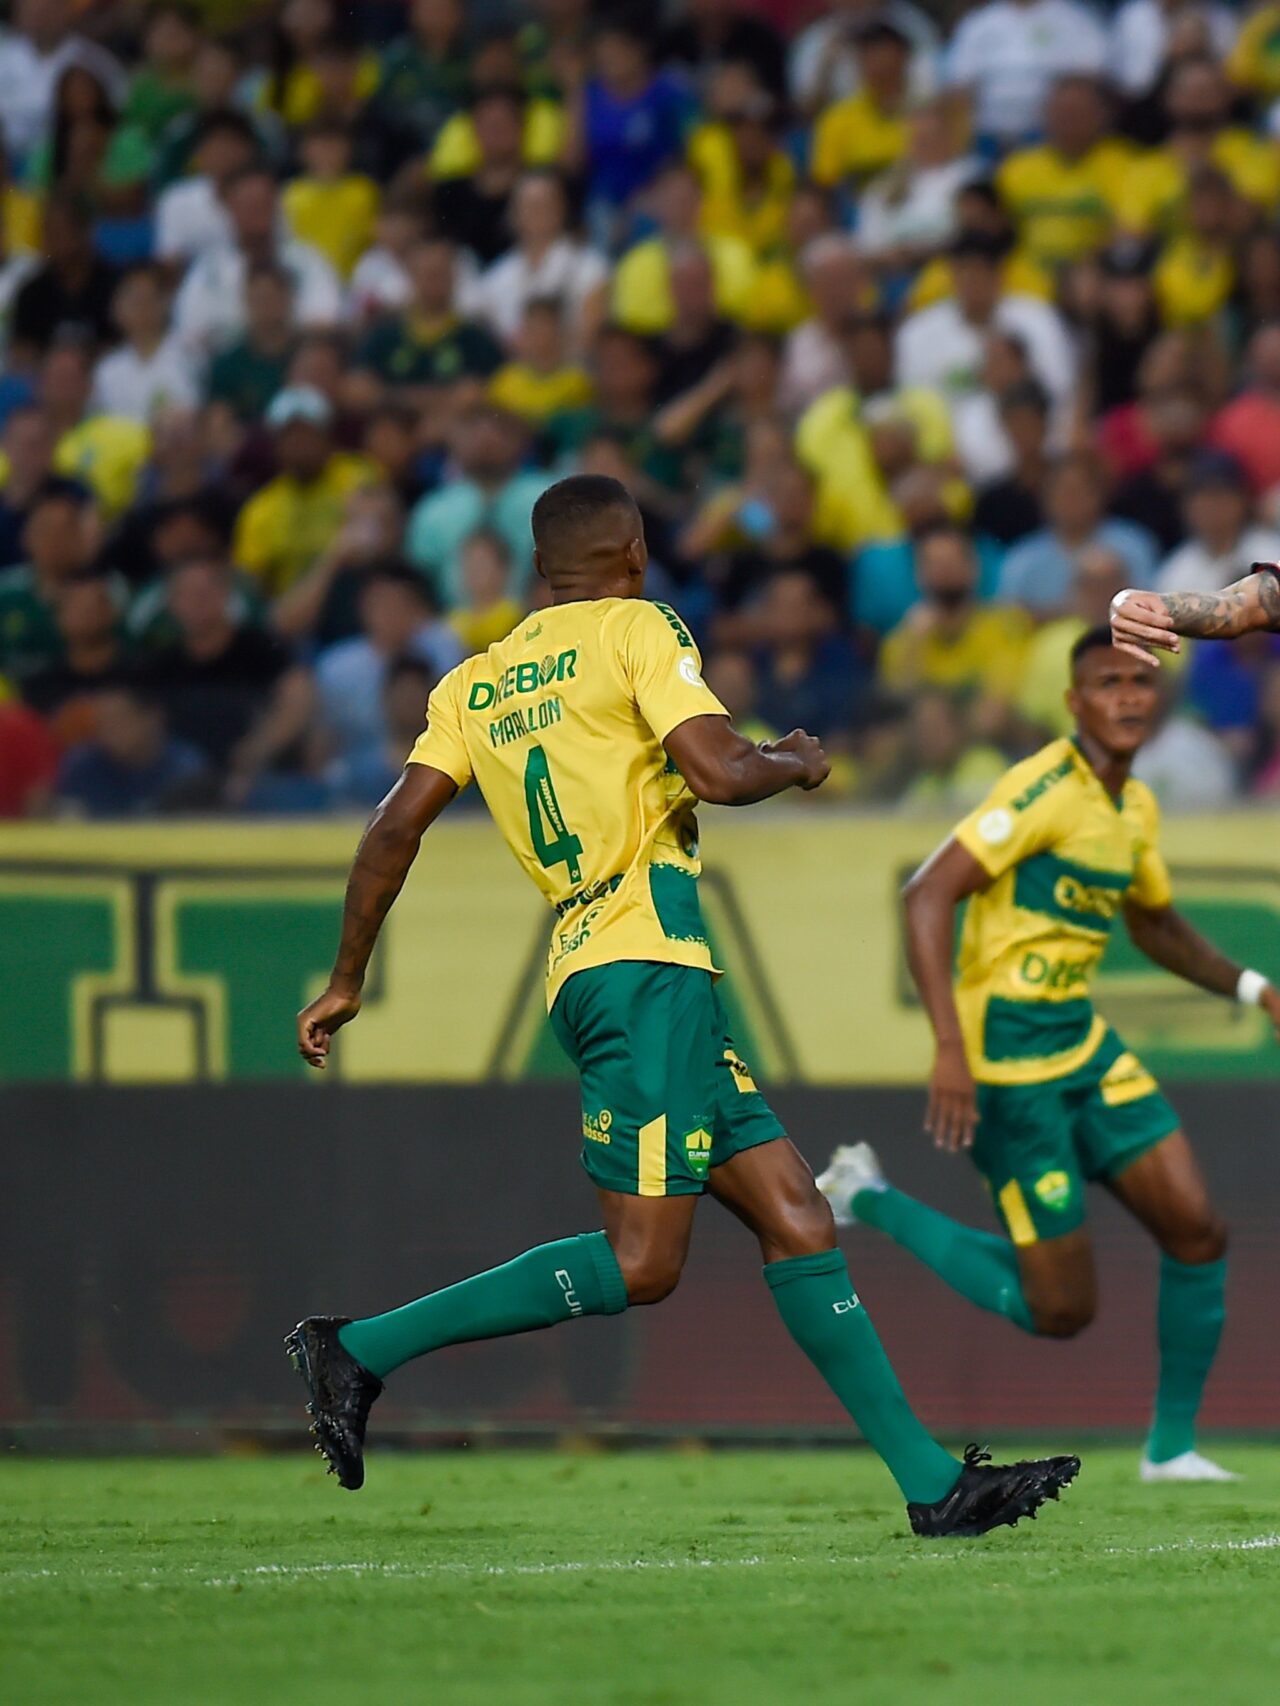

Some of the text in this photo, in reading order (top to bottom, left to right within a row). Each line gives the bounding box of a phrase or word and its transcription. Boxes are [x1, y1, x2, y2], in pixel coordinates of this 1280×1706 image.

[468, 649, 577, 710] DREBOR
[524, 744, 584, 885] 4
[554, 1269, 583, 1316] CUI
